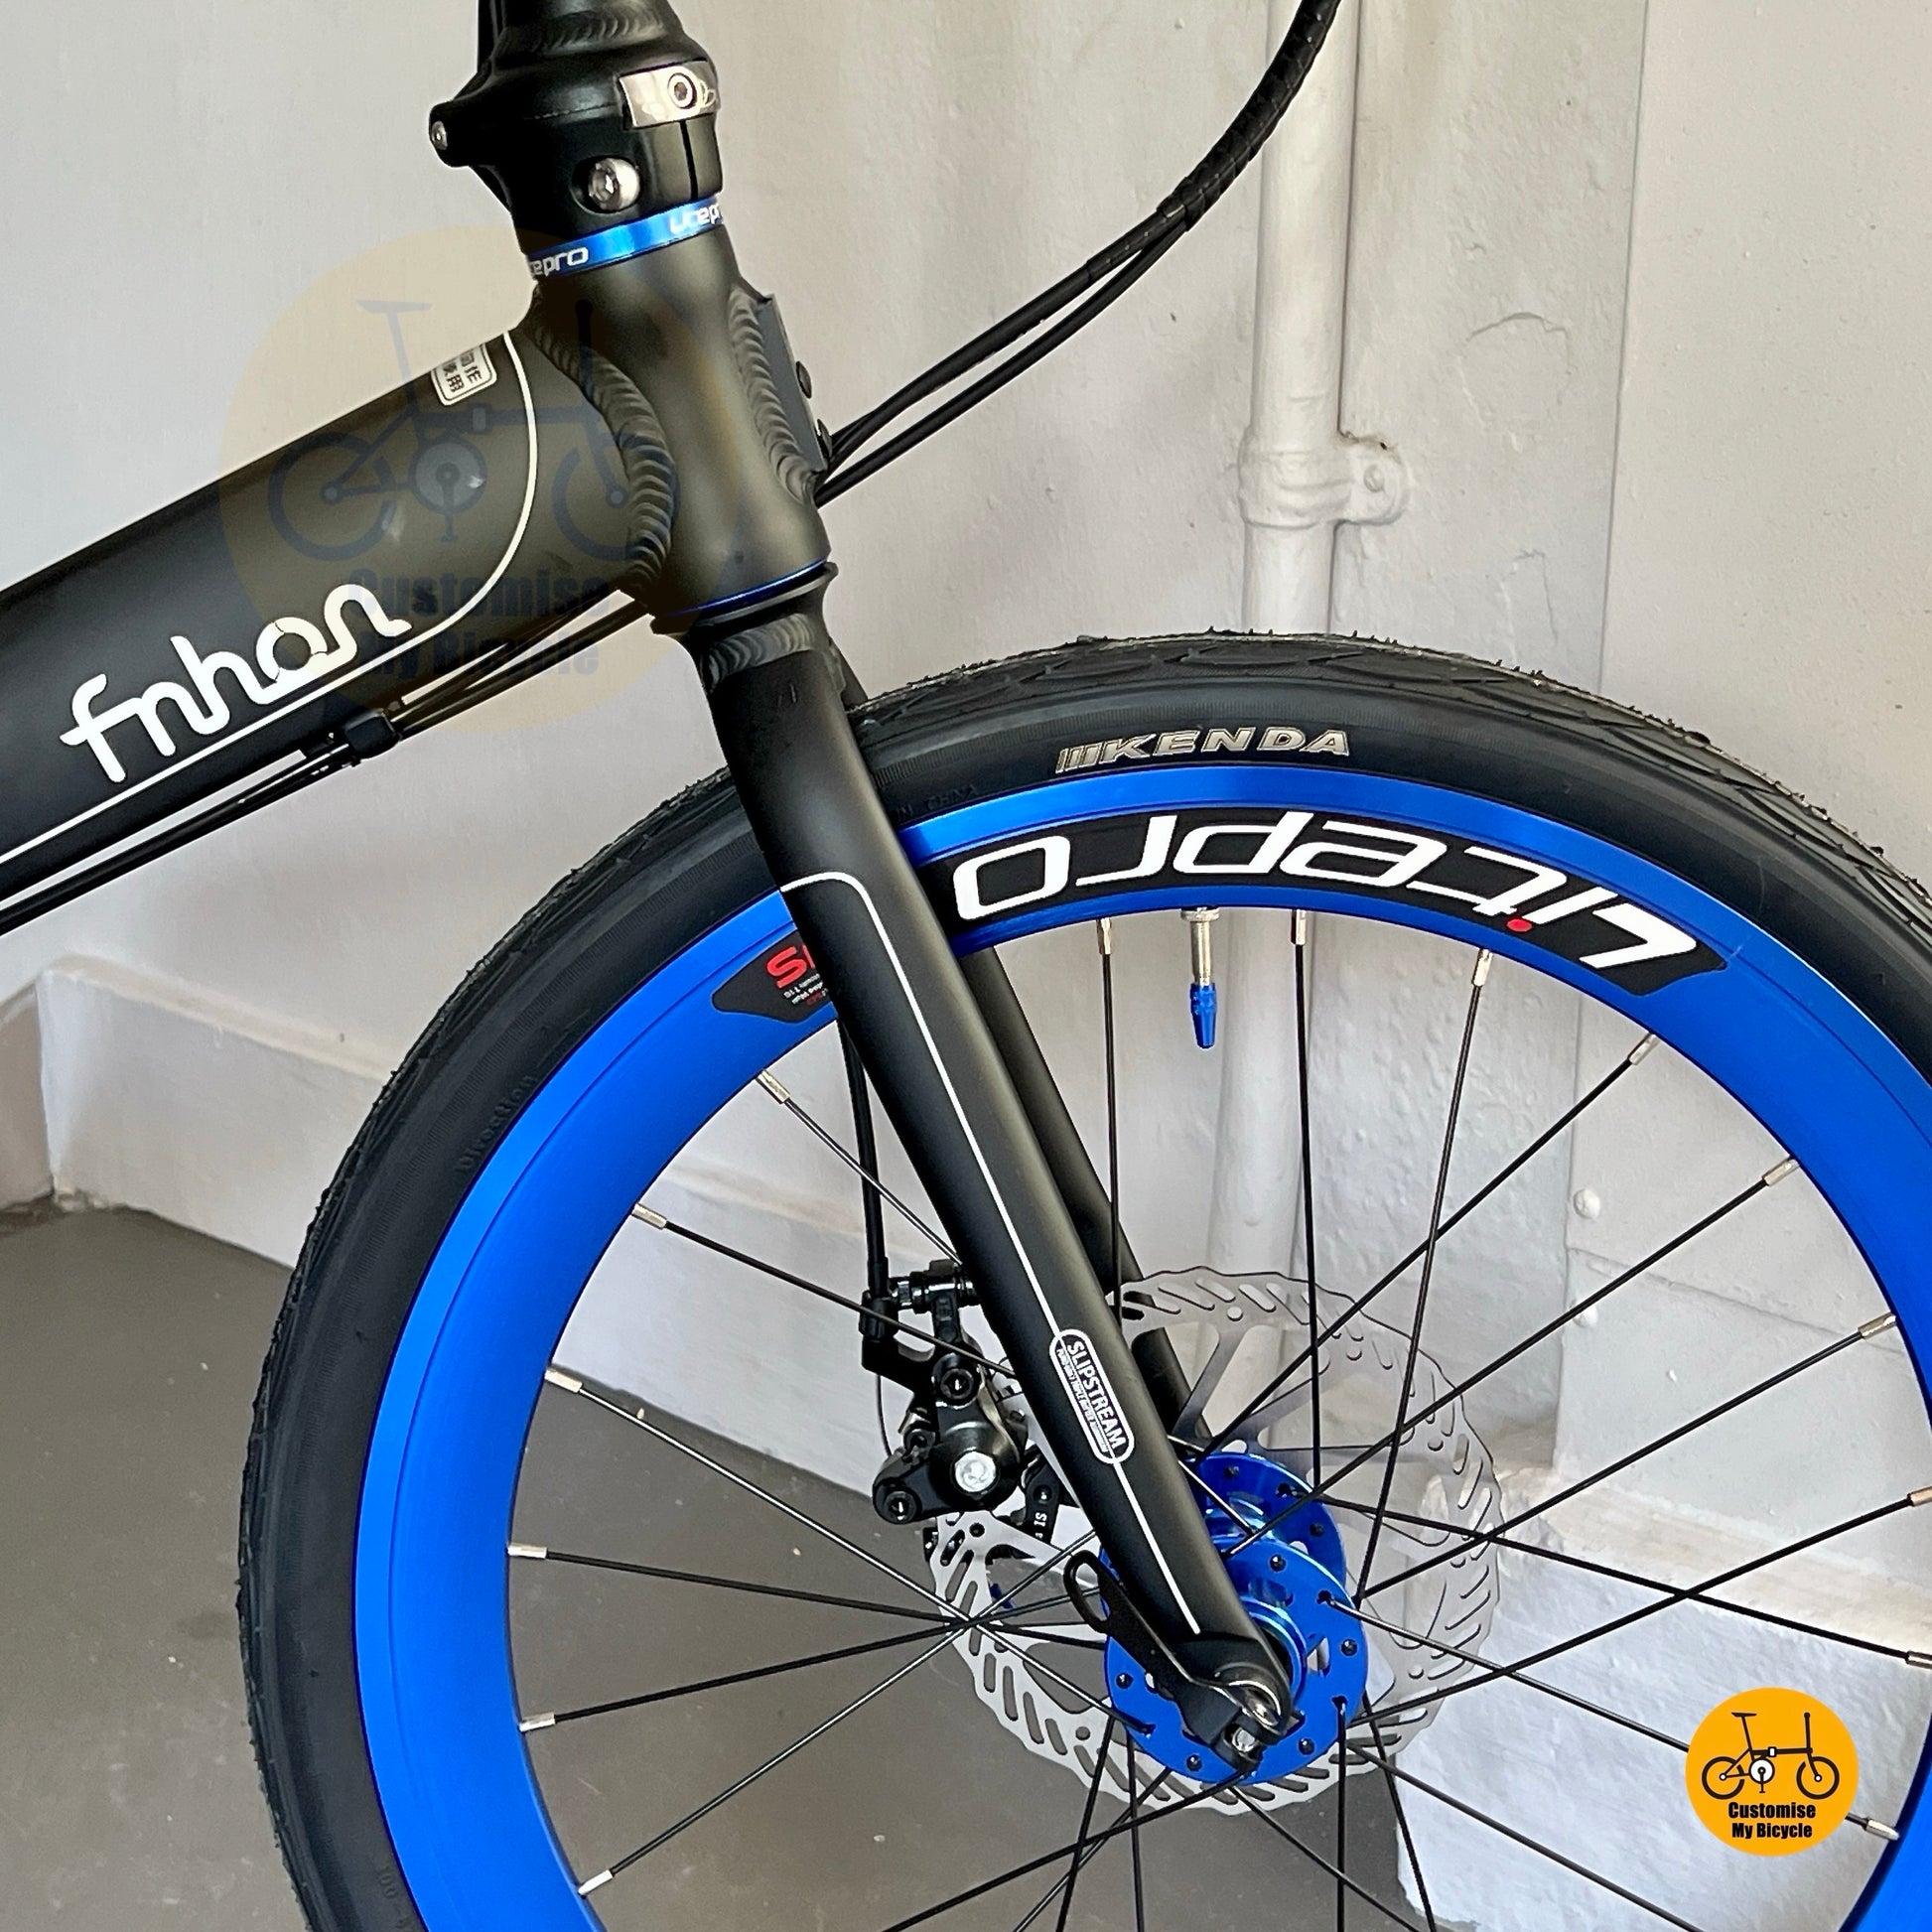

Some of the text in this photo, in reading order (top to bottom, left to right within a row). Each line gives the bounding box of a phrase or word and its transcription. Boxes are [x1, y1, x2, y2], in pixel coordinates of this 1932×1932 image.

[60, 584, 412, 783] fnhon
[1090, 726, 1350, 770] KENDA
[1067, 1340, 1127, 1449] SLIPSTREAM
